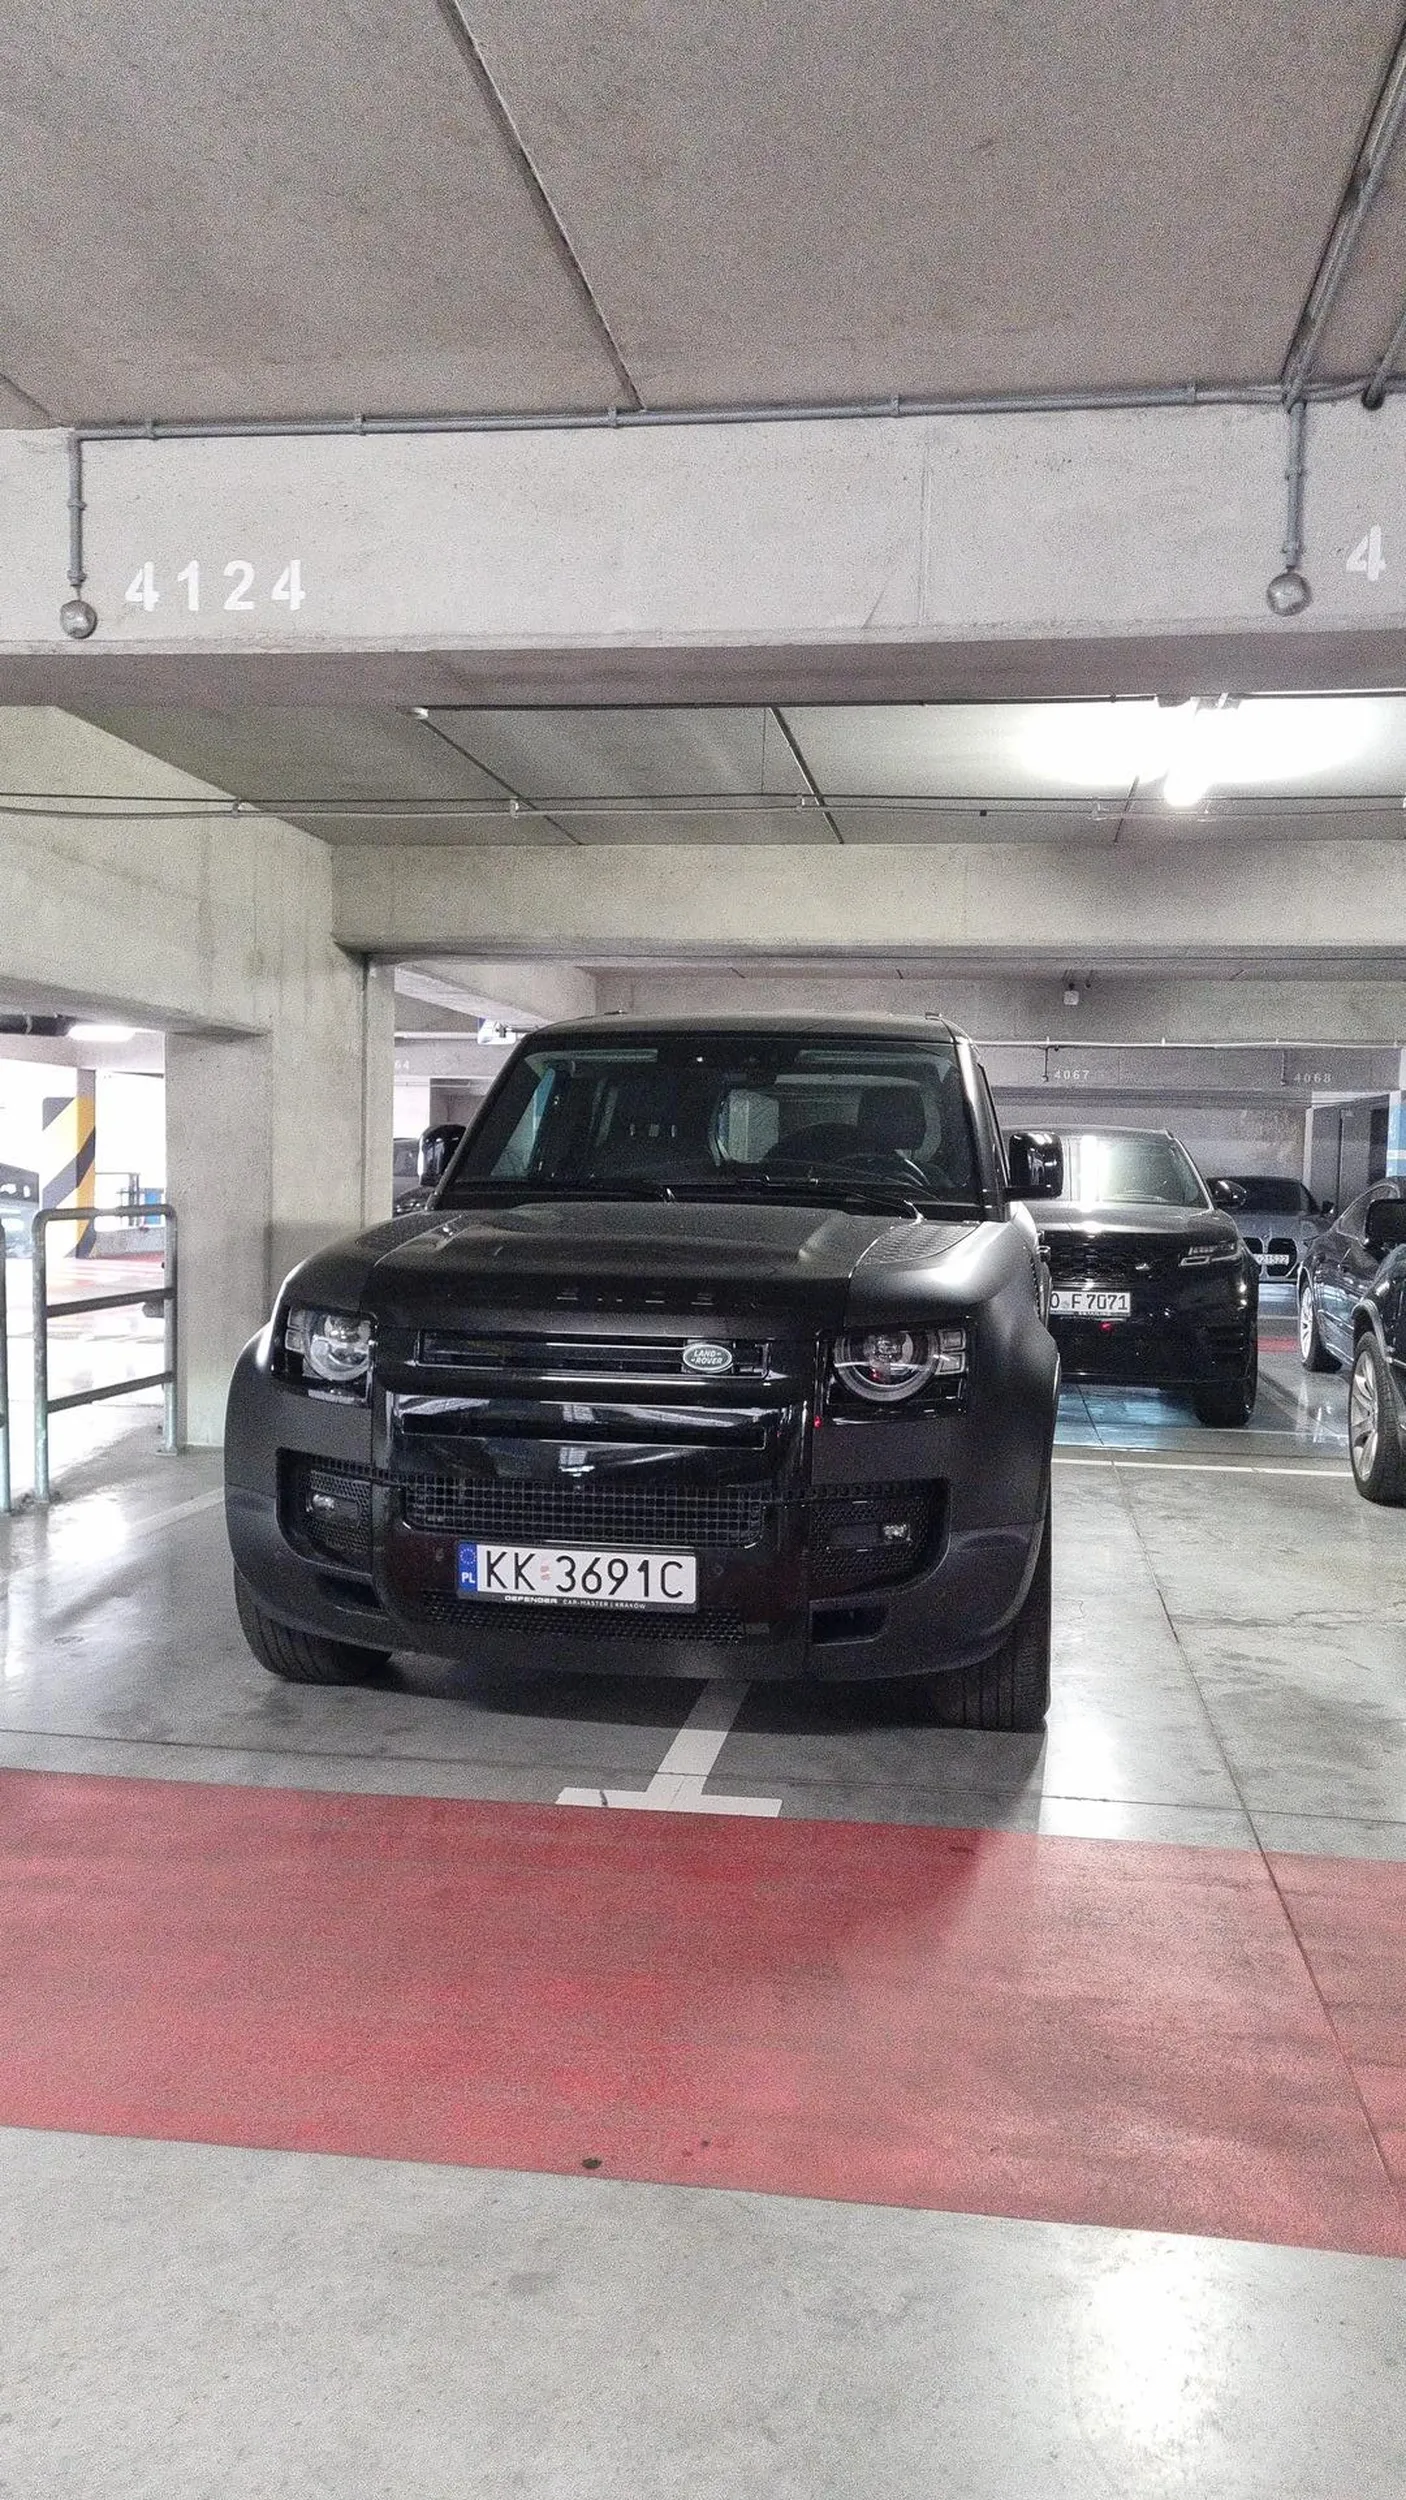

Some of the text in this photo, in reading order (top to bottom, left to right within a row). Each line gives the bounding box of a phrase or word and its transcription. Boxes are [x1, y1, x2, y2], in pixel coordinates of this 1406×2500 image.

[1346, 525, 1387, 580] 4
[125, 560, 306, 611] 4124
[1054, 1069, 1090, 1080] 4067
[1294, 1073, 1331, 1083] 4068
[1071, 1293, 1082, 1309] F
[1086, 1294, 1128, 1310] 7071
[461, 1572, 476, 1584] PL
[486, 1551, 683, 1598] KK 3691C
[504, 1595, 558, 1604] DEFENDER
